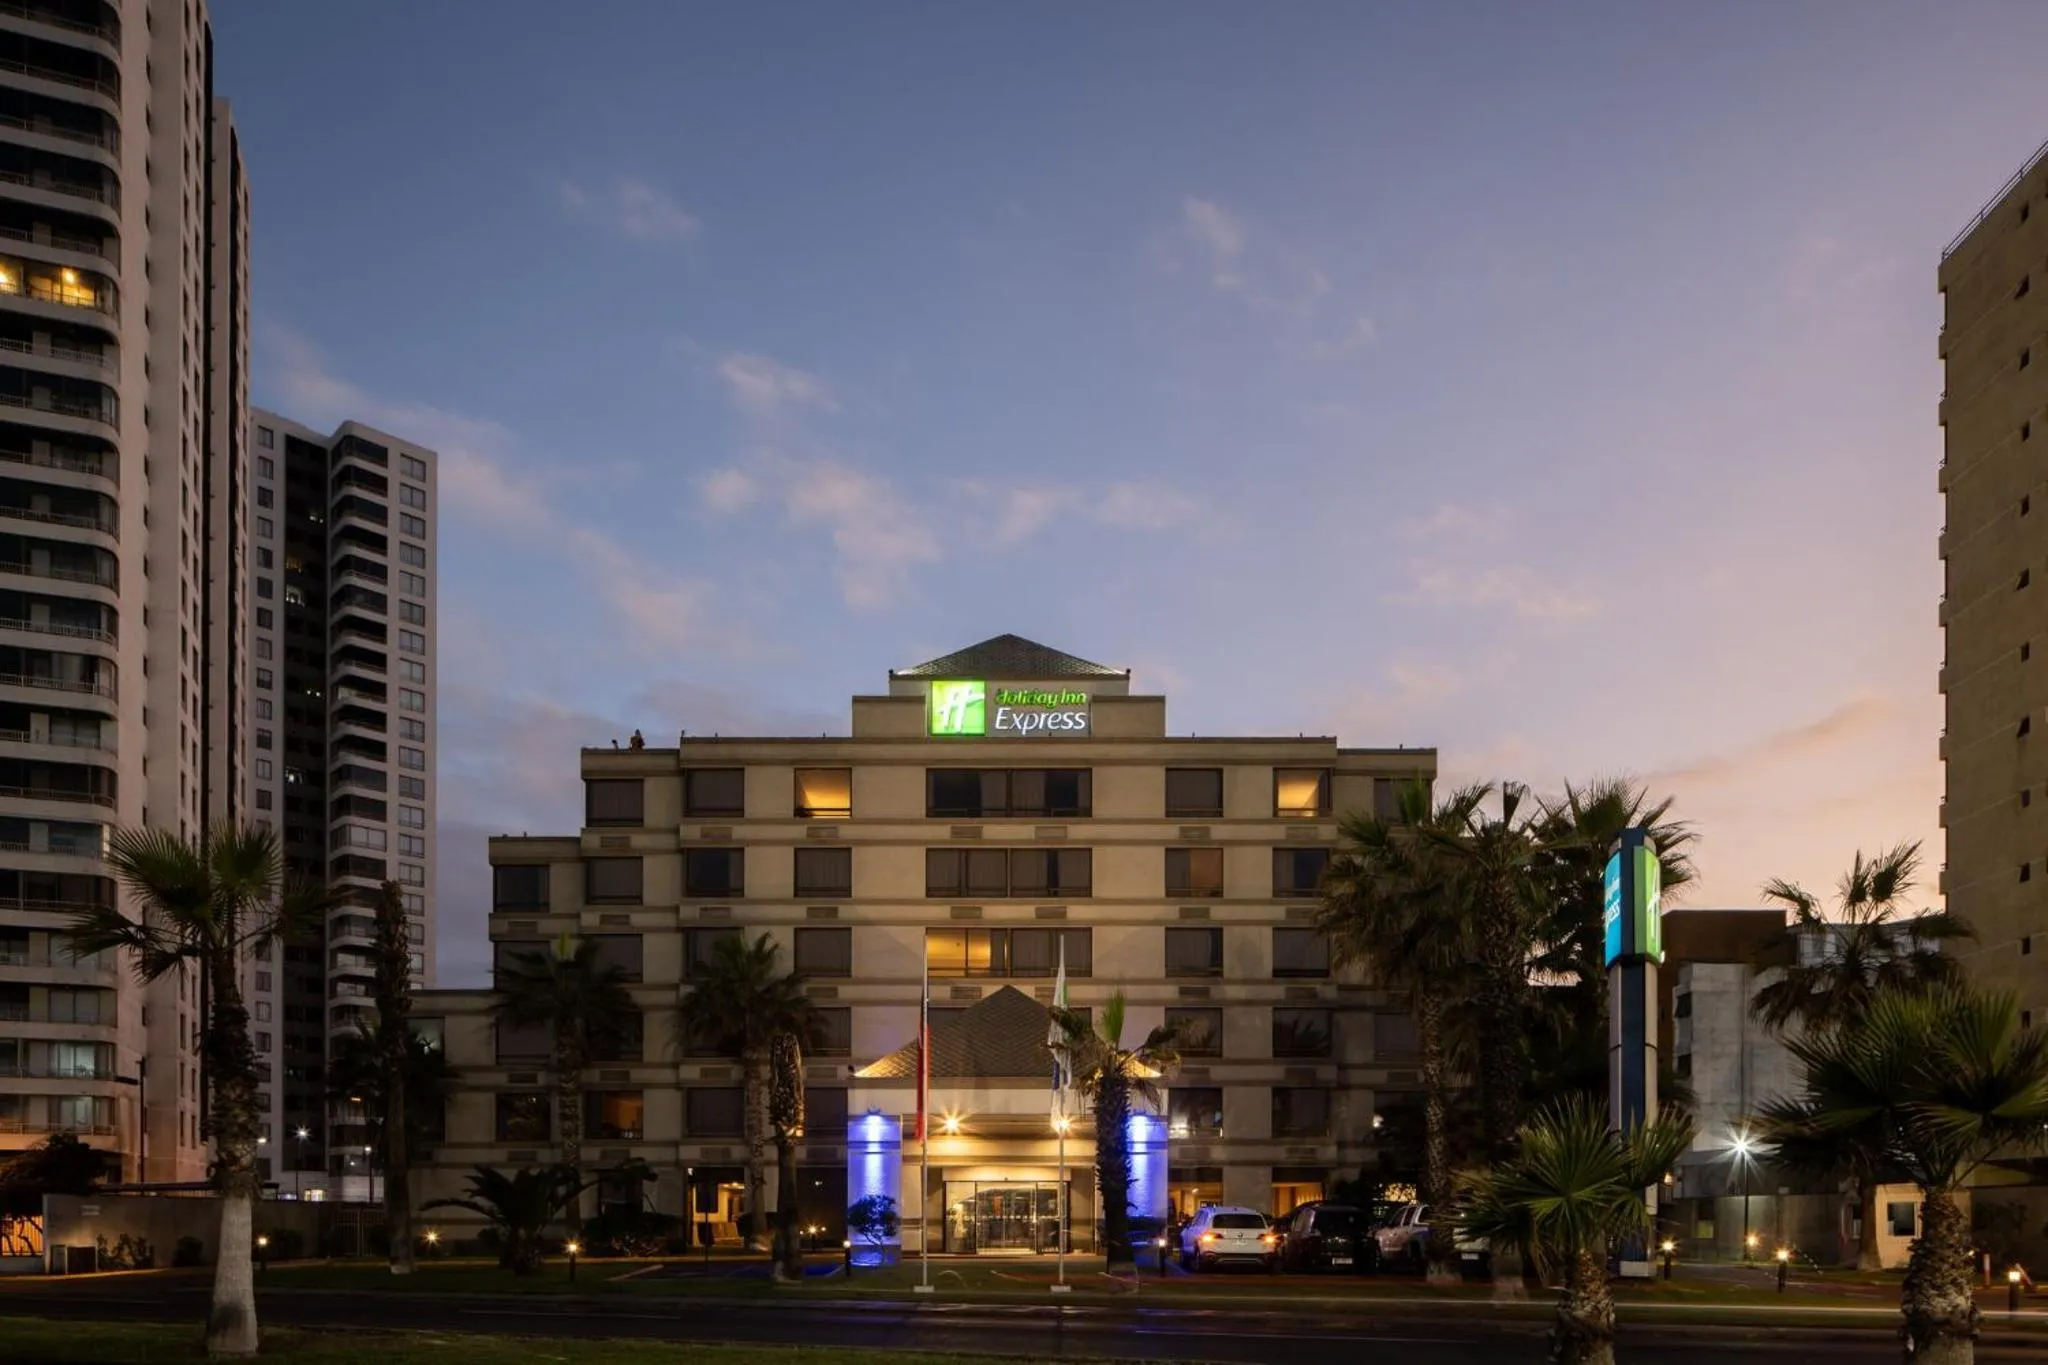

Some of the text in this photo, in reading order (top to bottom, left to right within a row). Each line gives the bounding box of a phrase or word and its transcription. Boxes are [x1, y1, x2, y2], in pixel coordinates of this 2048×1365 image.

[995, 688, 1088, 709] Holiday Inn
[994, 707, 1088, 736] Express
